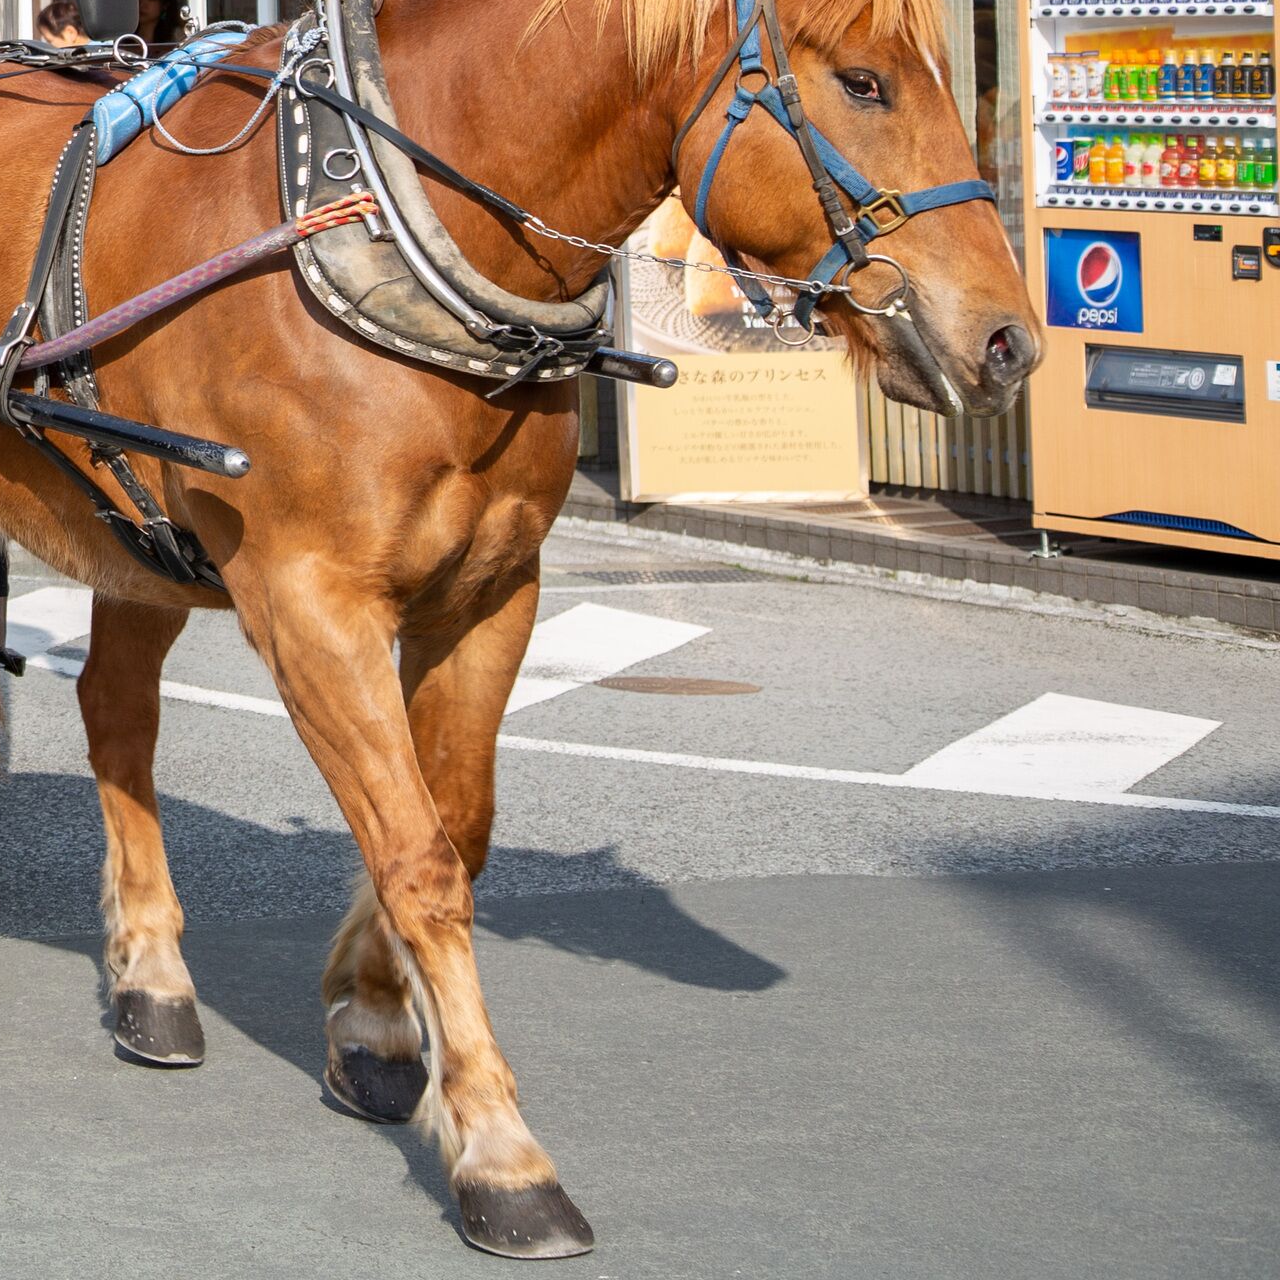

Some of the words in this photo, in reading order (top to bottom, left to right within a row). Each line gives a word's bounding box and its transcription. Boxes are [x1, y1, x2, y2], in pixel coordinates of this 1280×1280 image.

[1077, 307, 1118, 326] pepsi
[677, 368, 827, 385] さな森のプリンセス
